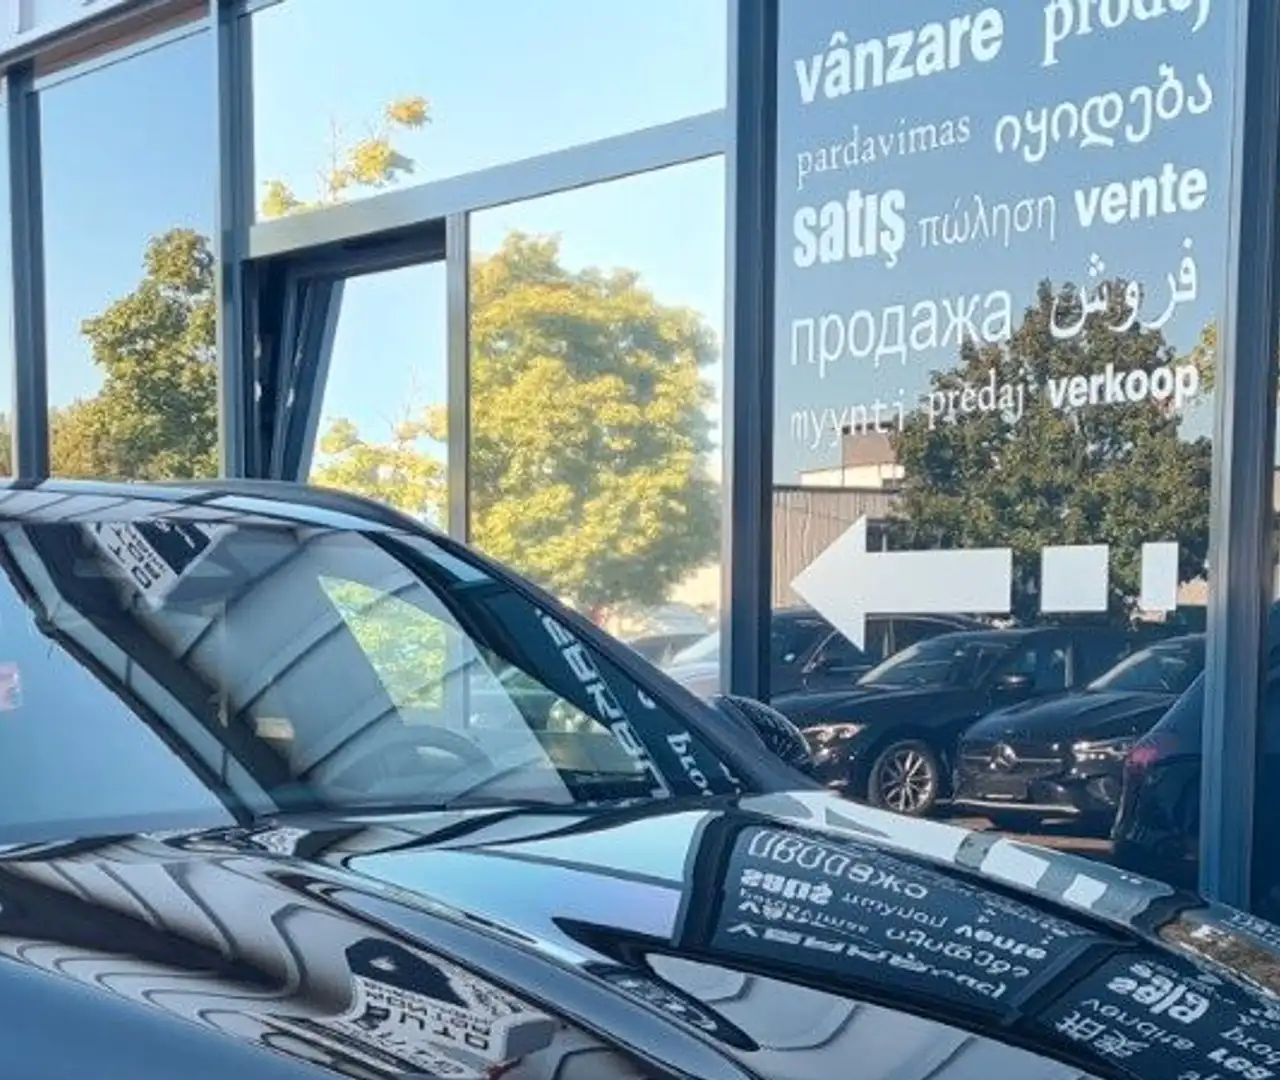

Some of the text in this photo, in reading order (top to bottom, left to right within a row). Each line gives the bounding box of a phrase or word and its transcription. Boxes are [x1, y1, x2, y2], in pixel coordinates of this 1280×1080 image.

[794, 8, 1004, 105] vânzare
[796, 116, 971, 189] pardavimas
[792, 189, 906, 269] satış
[919, 195, 1056, 250] πώληση
[1074, 163, 1208, 227] vente
[1050, 236, 1197, 339] فروش
[790, 290, 1012, 378] продажа
[789, 362, 1200, 449] myynti predaj verkoop
